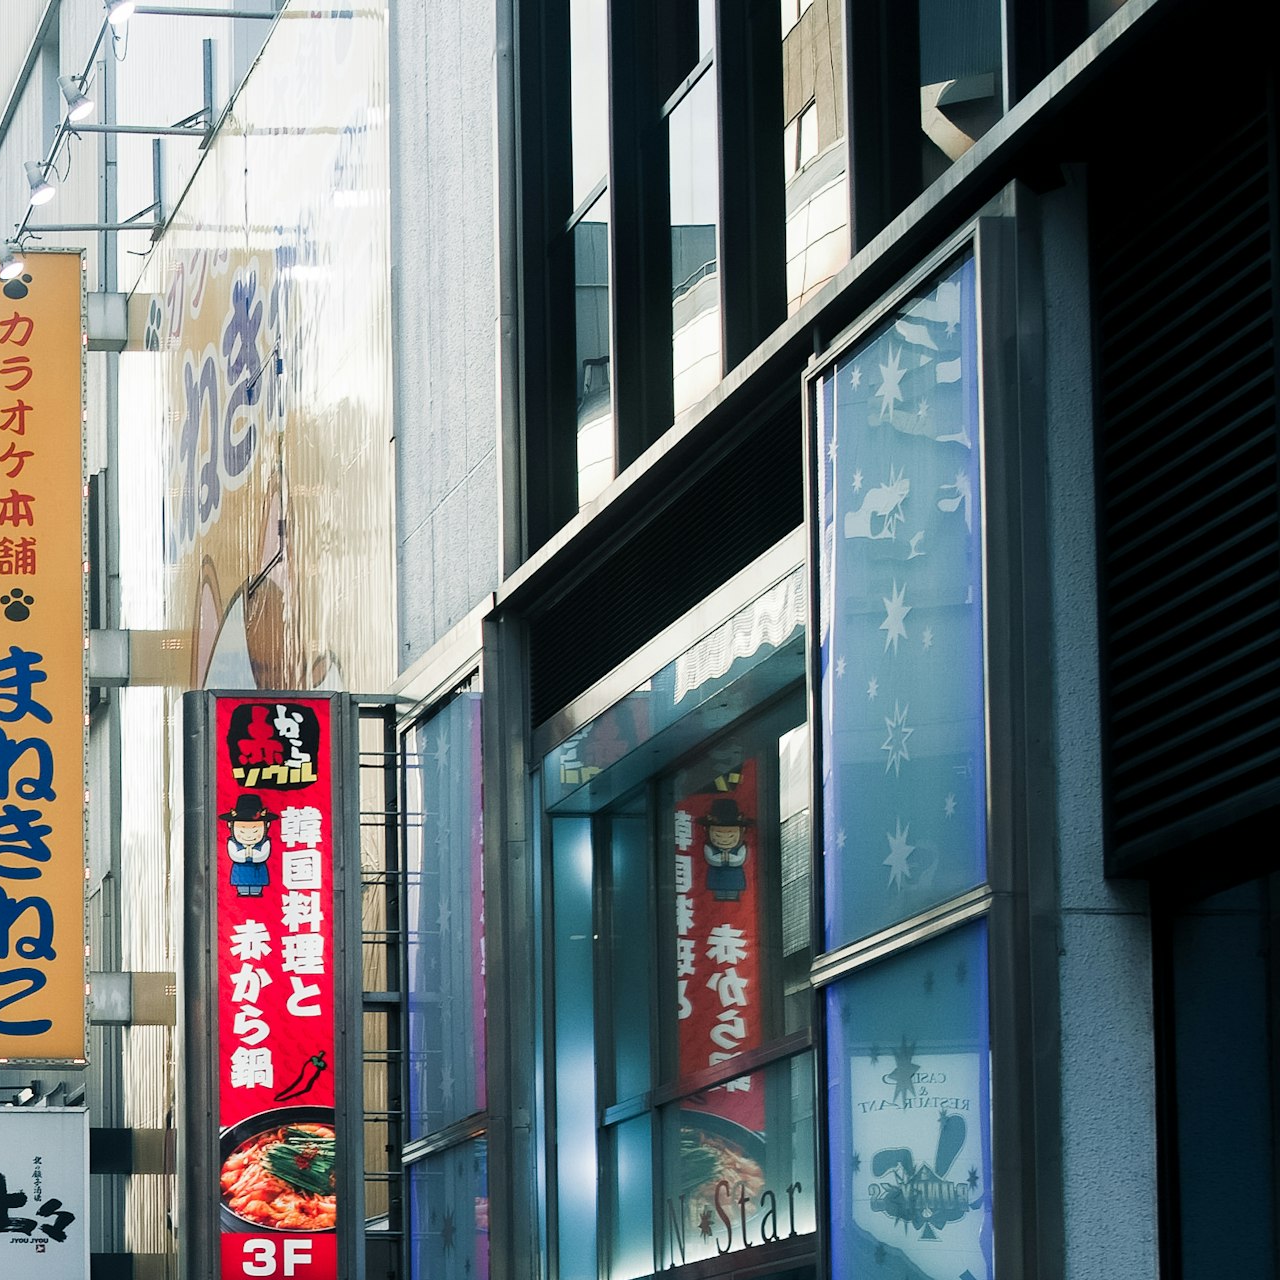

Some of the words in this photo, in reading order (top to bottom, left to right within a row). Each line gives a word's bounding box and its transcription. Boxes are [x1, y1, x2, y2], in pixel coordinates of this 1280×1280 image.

[232, 761, 318, 787] ソウル
[279, 806, 325, 1019] 韓国料理と
[228, 919, 275, 1090] 赤から鍋
[241, 1237, 312, 1278] 3F
[669, 1192, 688, 1269] N
[715, 1179, 804, 1260] Star
